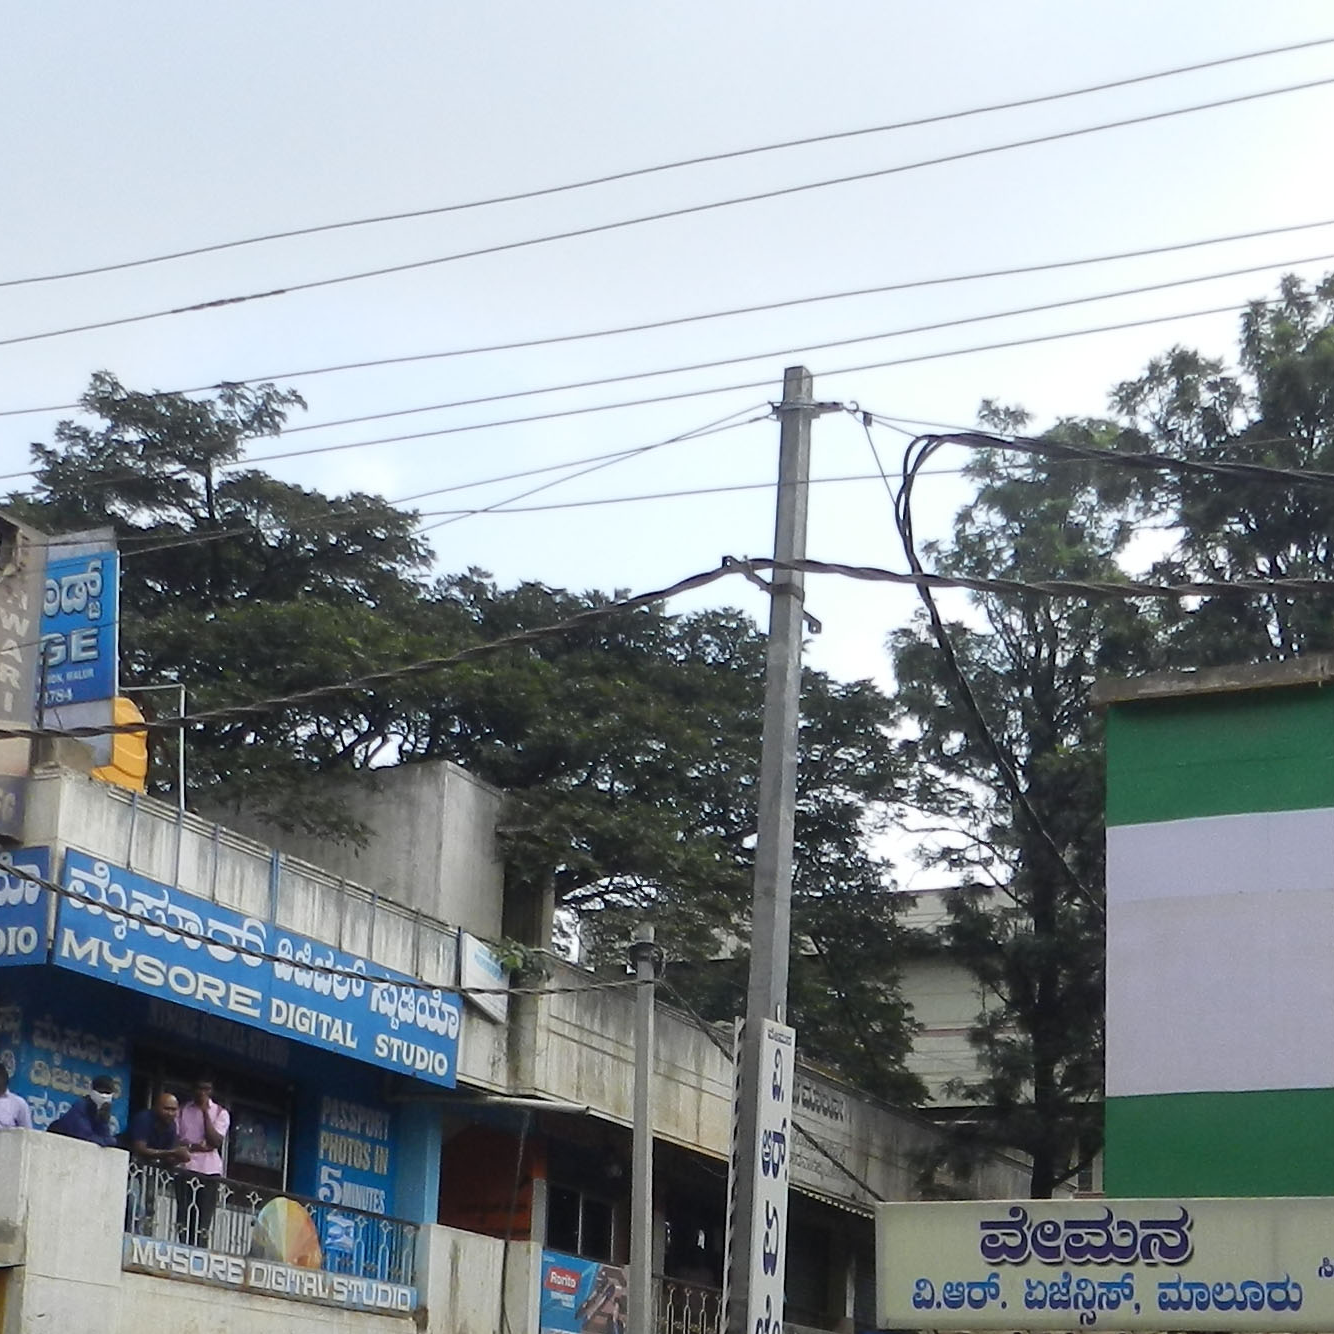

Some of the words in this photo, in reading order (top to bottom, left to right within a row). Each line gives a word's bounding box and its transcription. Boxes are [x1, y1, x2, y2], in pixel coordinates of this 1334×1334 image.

[60, 929, 262, 1018] MYSORE
[269, 998, 357, 1049] DIGITAL
[374, 1034, 449, 1078] STUDIO
[320, 1130, 371, 1171] PHOTOS
[318, 1164, 342, 1204] 5
[979, 1206, 1195, 1266] ವೇಮನ
[132, 1237, 246, 1286] MYSORE
[251, 1257, 327, 1299] DIGITAL
[332, 1277, 412, 1312] STUDIO
[1157, 1273, 1304, 1313] ಮಾಲೂರು
